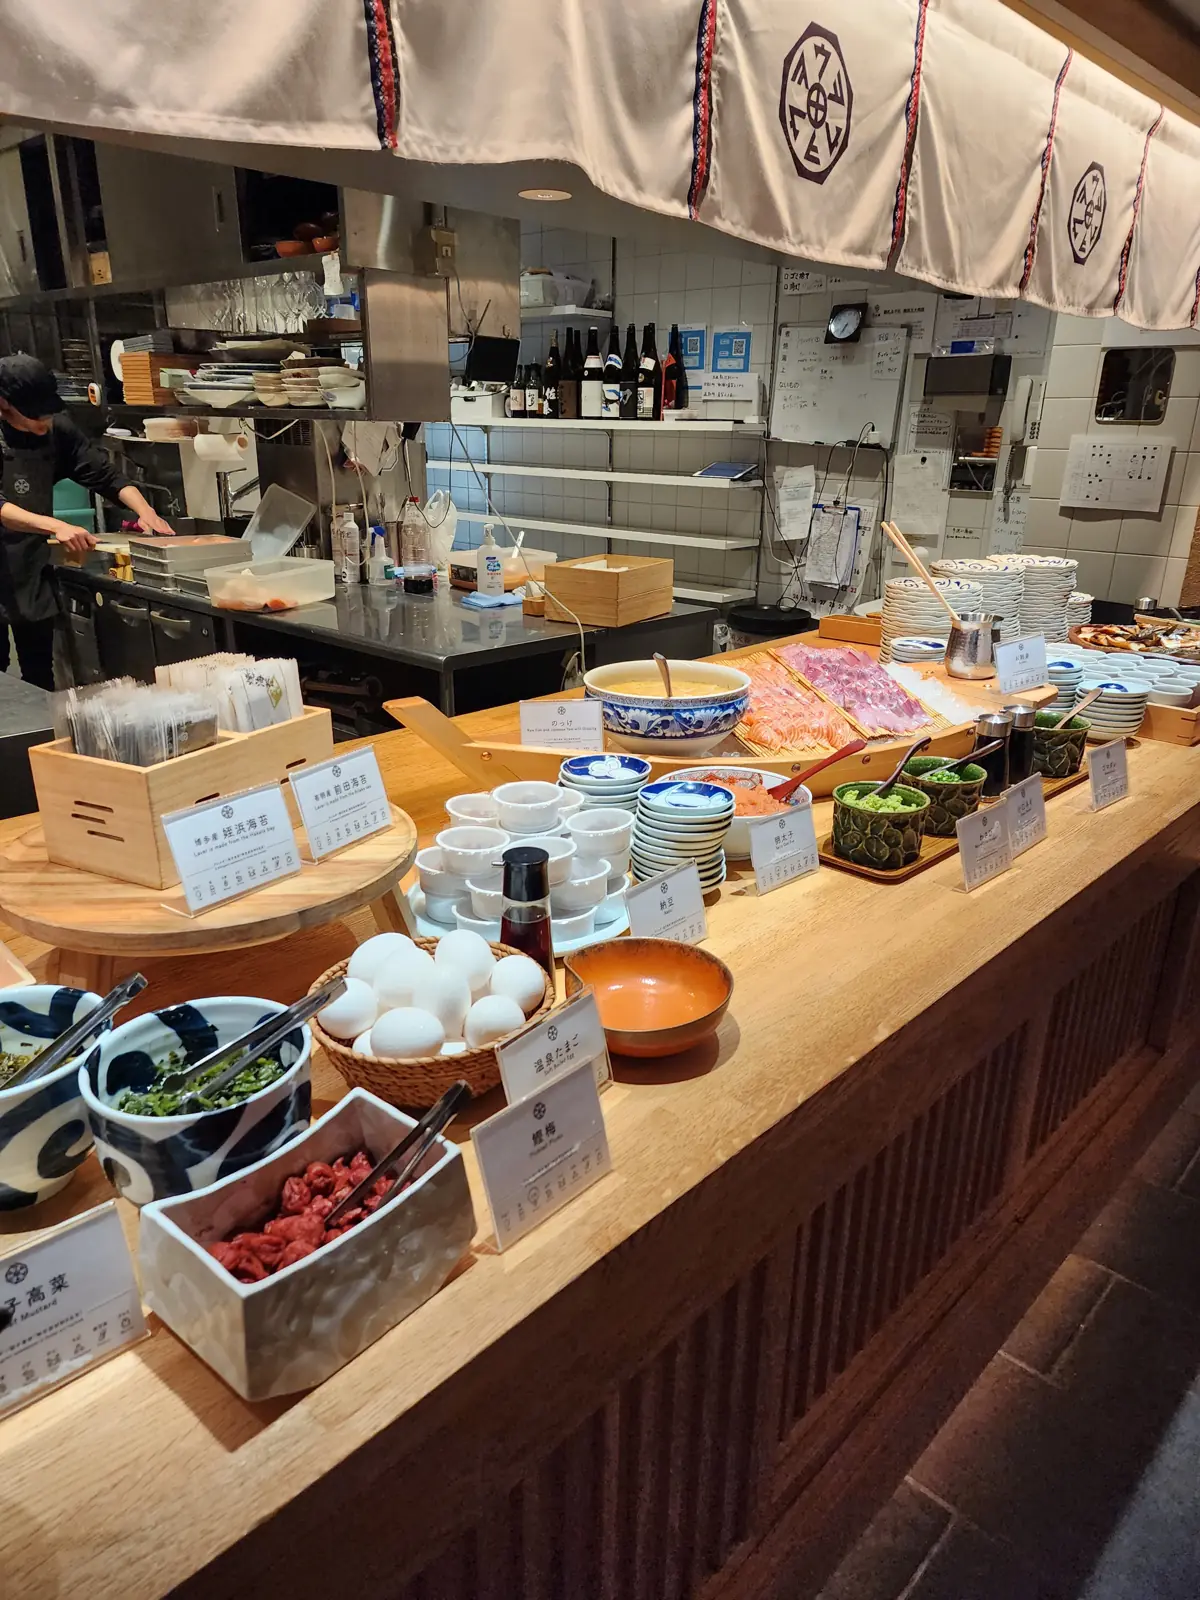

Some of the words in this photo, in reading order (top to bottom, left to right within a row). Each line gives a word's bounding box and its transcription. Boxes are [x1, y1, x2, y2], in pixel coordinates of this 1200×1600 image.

[334, 774, 367, 796] 前田海苔
[194, 832, 218, 846] 博多産
[222, 814, 269, 839] 姪浜海苔
[214, 842, 228, 850] made
[534, 1033, 579, 1074] 温泉たまご
